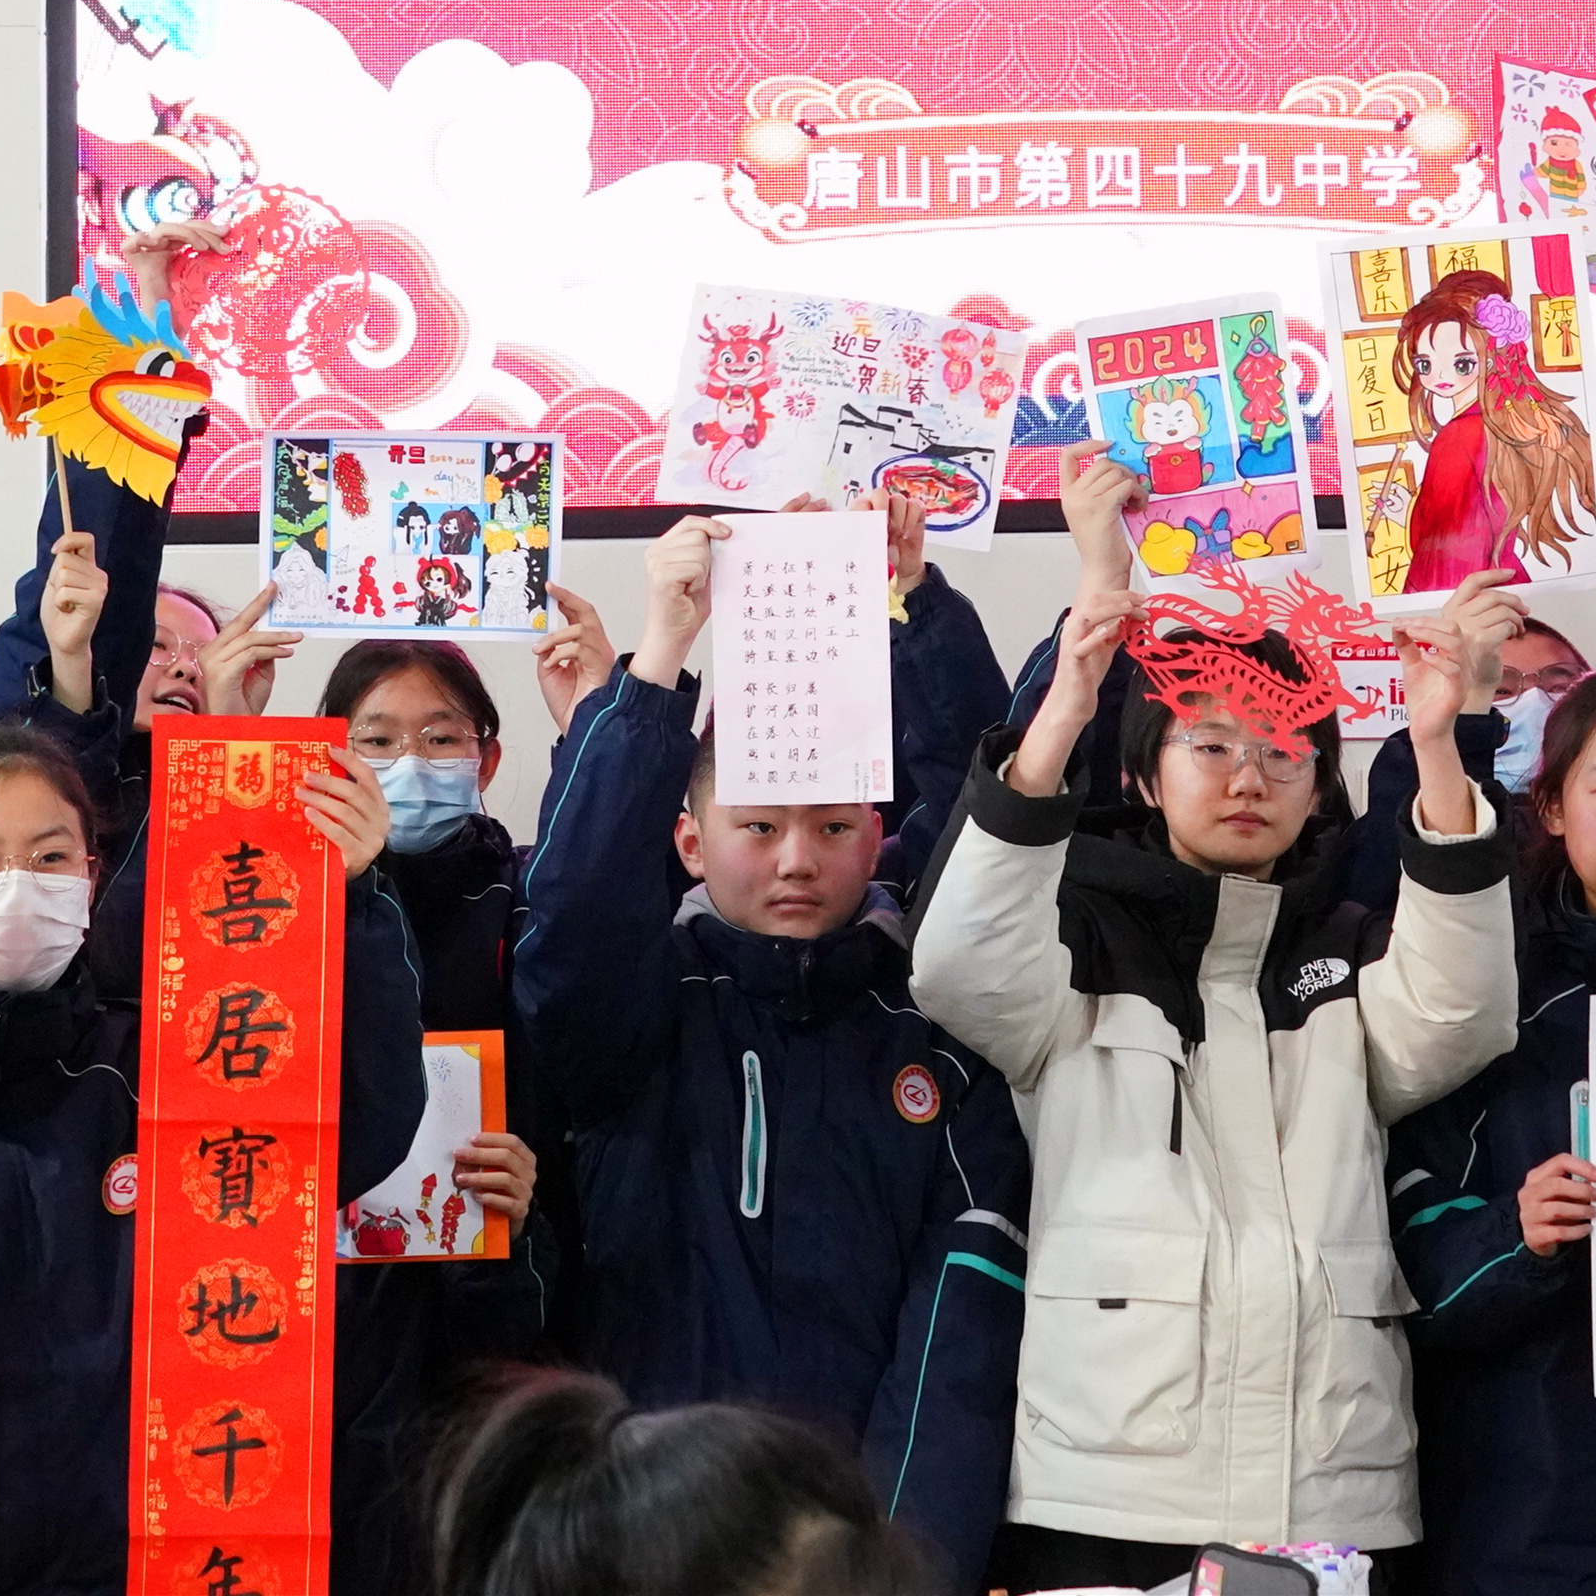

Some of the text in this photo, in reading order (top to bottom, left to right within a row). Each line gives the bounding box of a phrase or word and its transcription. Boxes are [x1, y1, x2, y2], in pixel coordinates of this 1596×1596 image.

[805, 141, 1422, 211] 唐山市第四十九中学
[1365, 250, 1398, 313] 喜乐
[1445, 246, 1479, 272] 福
[1096, 327, 1207, 381] 2024
[858, 364, 930, 406] 贺新春
[1357, 338, 1386, 432] 日复一日
